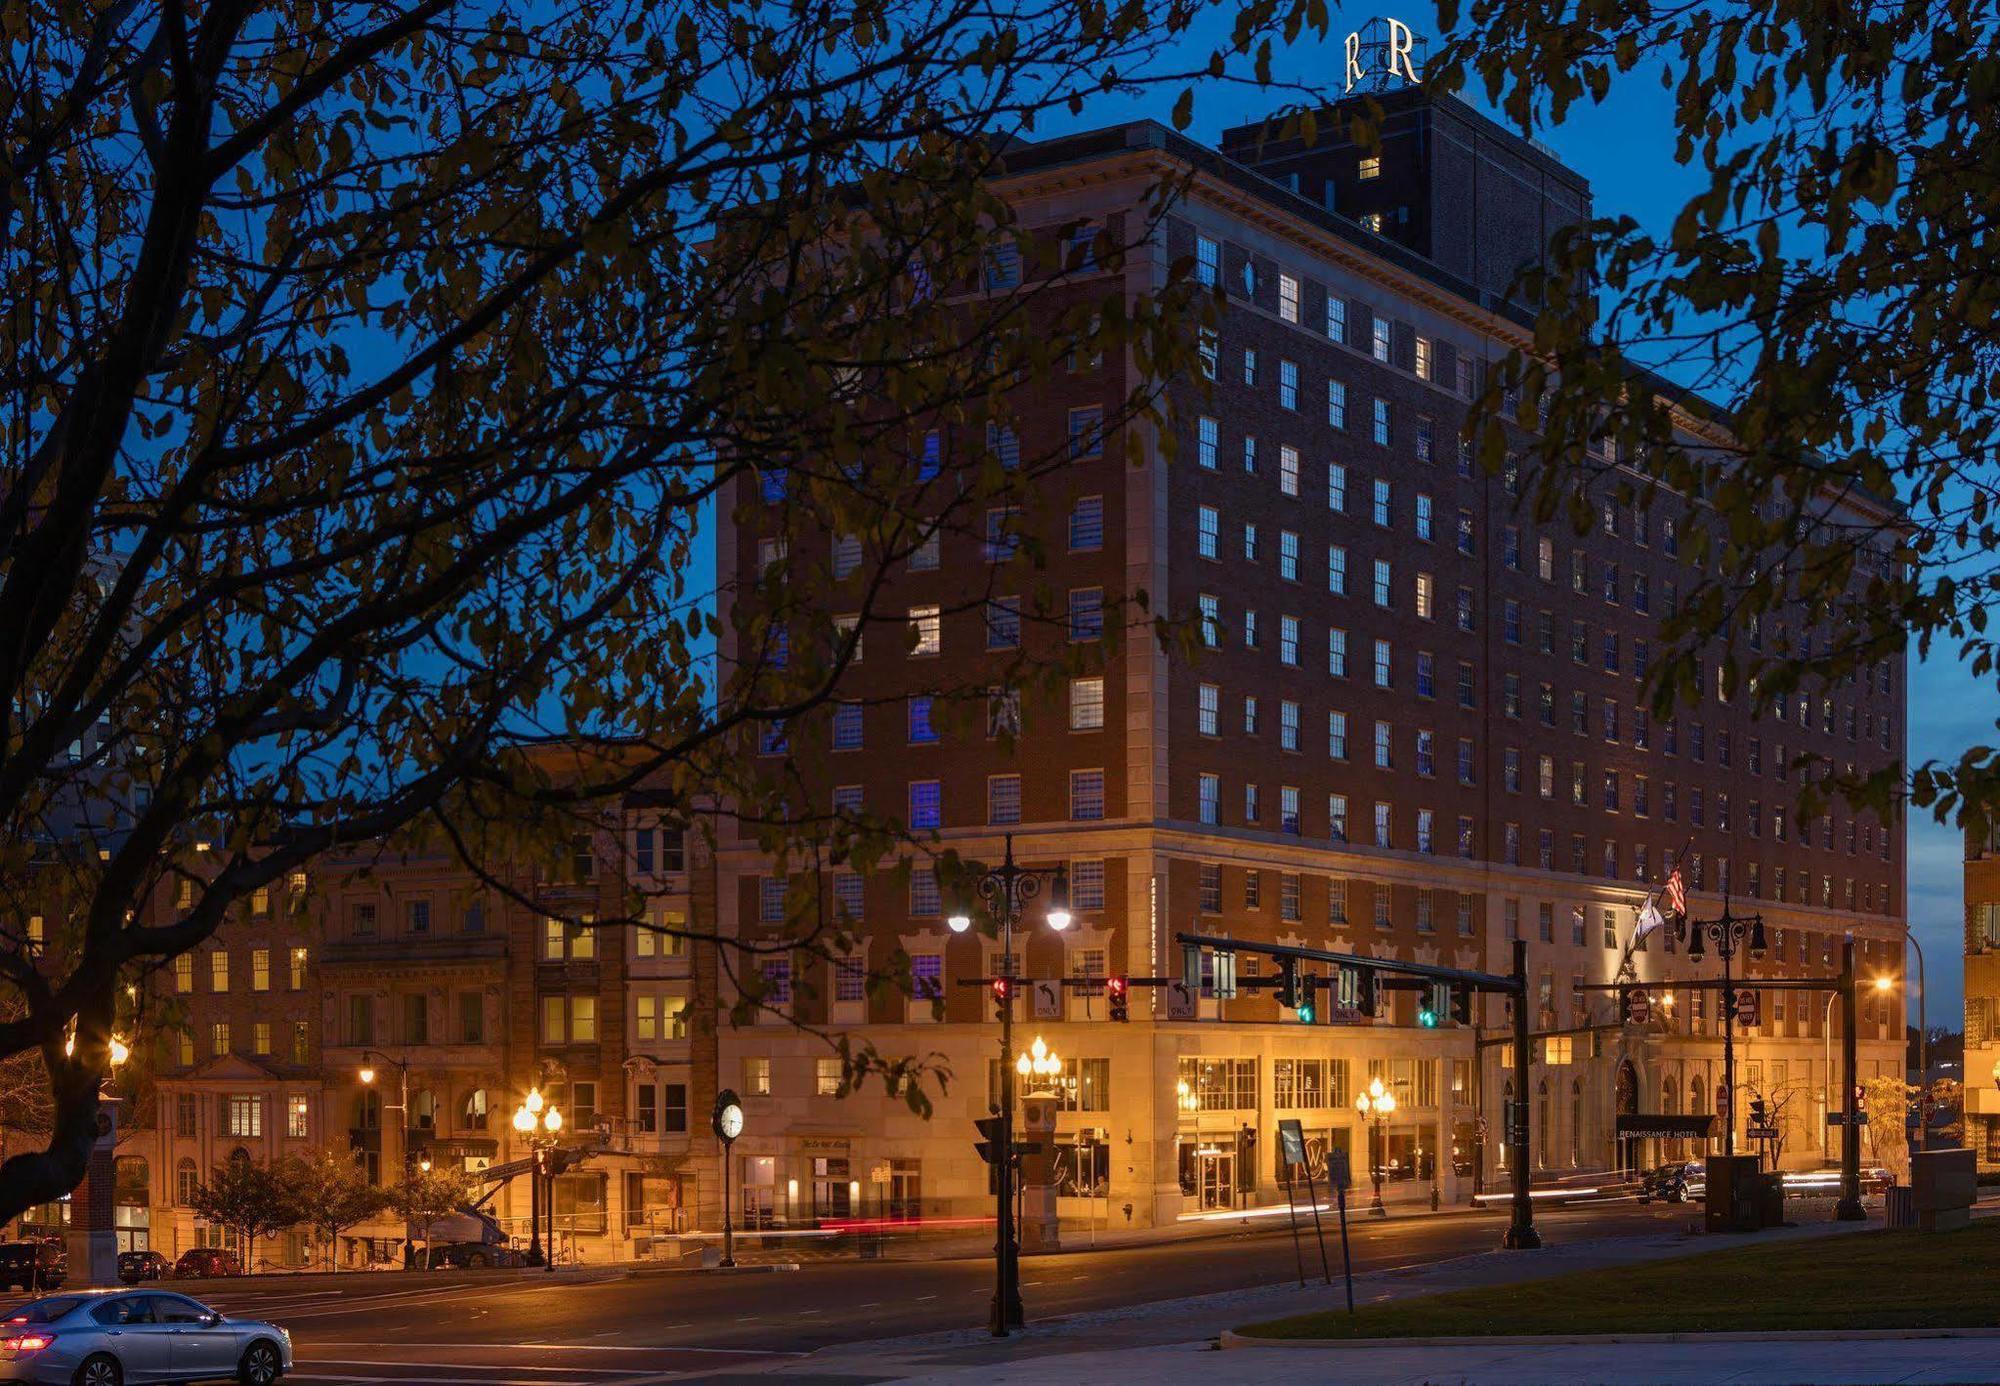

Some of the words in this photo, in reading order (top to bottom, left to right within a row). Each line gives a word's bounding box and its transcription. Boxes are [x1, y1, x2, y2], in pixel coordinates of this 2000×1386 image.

[1386, 17, 1422, 83] R
[1344, 31, 1366, 94] R
[1037, 1007, 1057, 1016] ONLY
[1170, 1007, 1191, 1016] ONLY
[1619, 1130, 1671, 1138] RENAISSANCE
[1673, 1130, 1698, 1139] HOTEL
